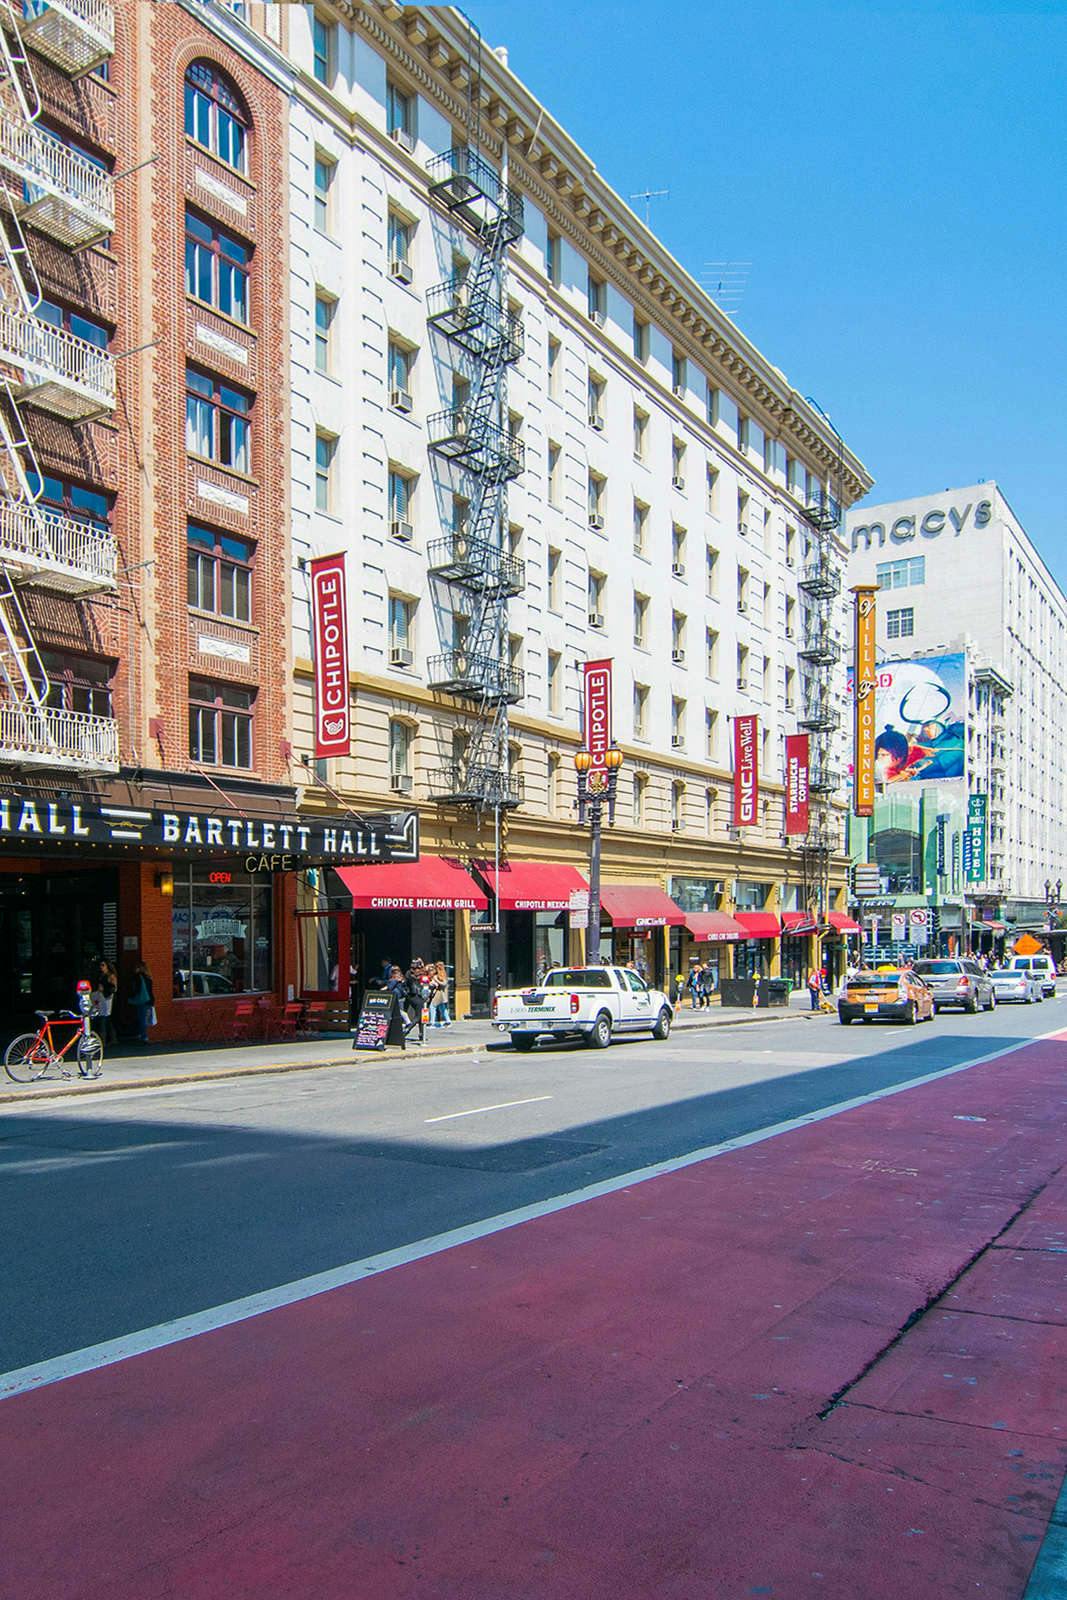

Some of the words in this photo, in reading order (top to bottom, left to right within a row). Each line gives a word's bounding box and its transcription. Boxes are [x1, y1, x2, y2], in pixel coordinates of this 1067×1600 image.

[852, 500, 991, 550] macys
[321, 579, 342, 705] CHIPOTLE
[859, 598, 876, 678] VILLA
[592, 676, 606, 765] CHIPOTLE
[858, 680, 876, 799] FLORENCE
[740, 772, 752, 821] GNC
[790, 757, 798, 813] STARBUCKS
[798, 767, 807, 802] COFFEE
[162, 813, 311, 851] BARTLETT
[323, 828, 381, 855] HALL
[972, 827, 982, 878] HOTEL
[209, 872, 231, 883] OPEN
[245, 854, 293, 873] CAFE
[371, 897, 414, 907] CHIPOTLE
[416, 897, 453, 908] MEXICAN
[454, 898, 476, 908] GRILL
[515, 899, 545, 909] CHIPOTLE
[547, 900, 569, 909] MEXICA
